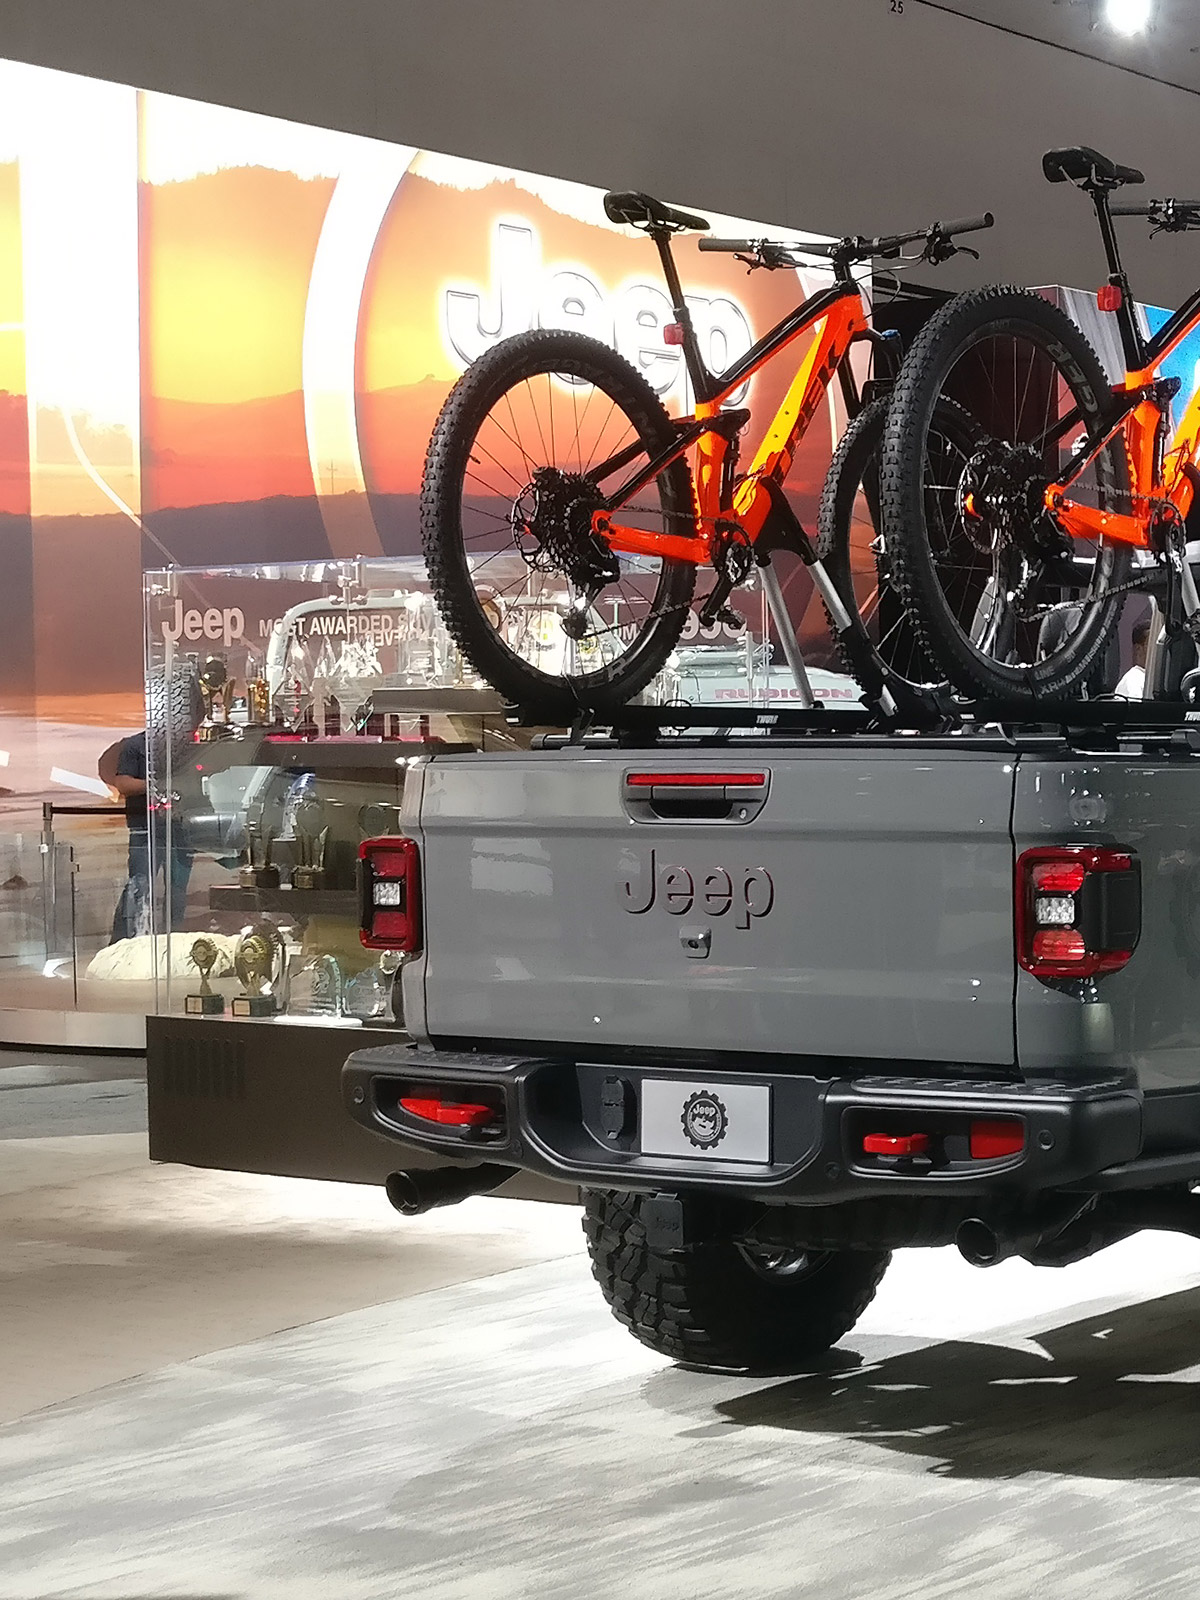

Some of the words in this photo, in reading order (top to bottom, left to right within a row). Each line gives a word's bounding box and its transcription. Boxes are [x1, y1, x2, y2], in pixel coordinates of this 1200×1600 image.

[446, 223, 753, 416] Jeep
[161, 599, 245, 647] Jeep
[309, 614, 393, 635] AWARDED
[616, 848, 774, 930] Jeep
[692, 1103, 717, 1117] Jeep
